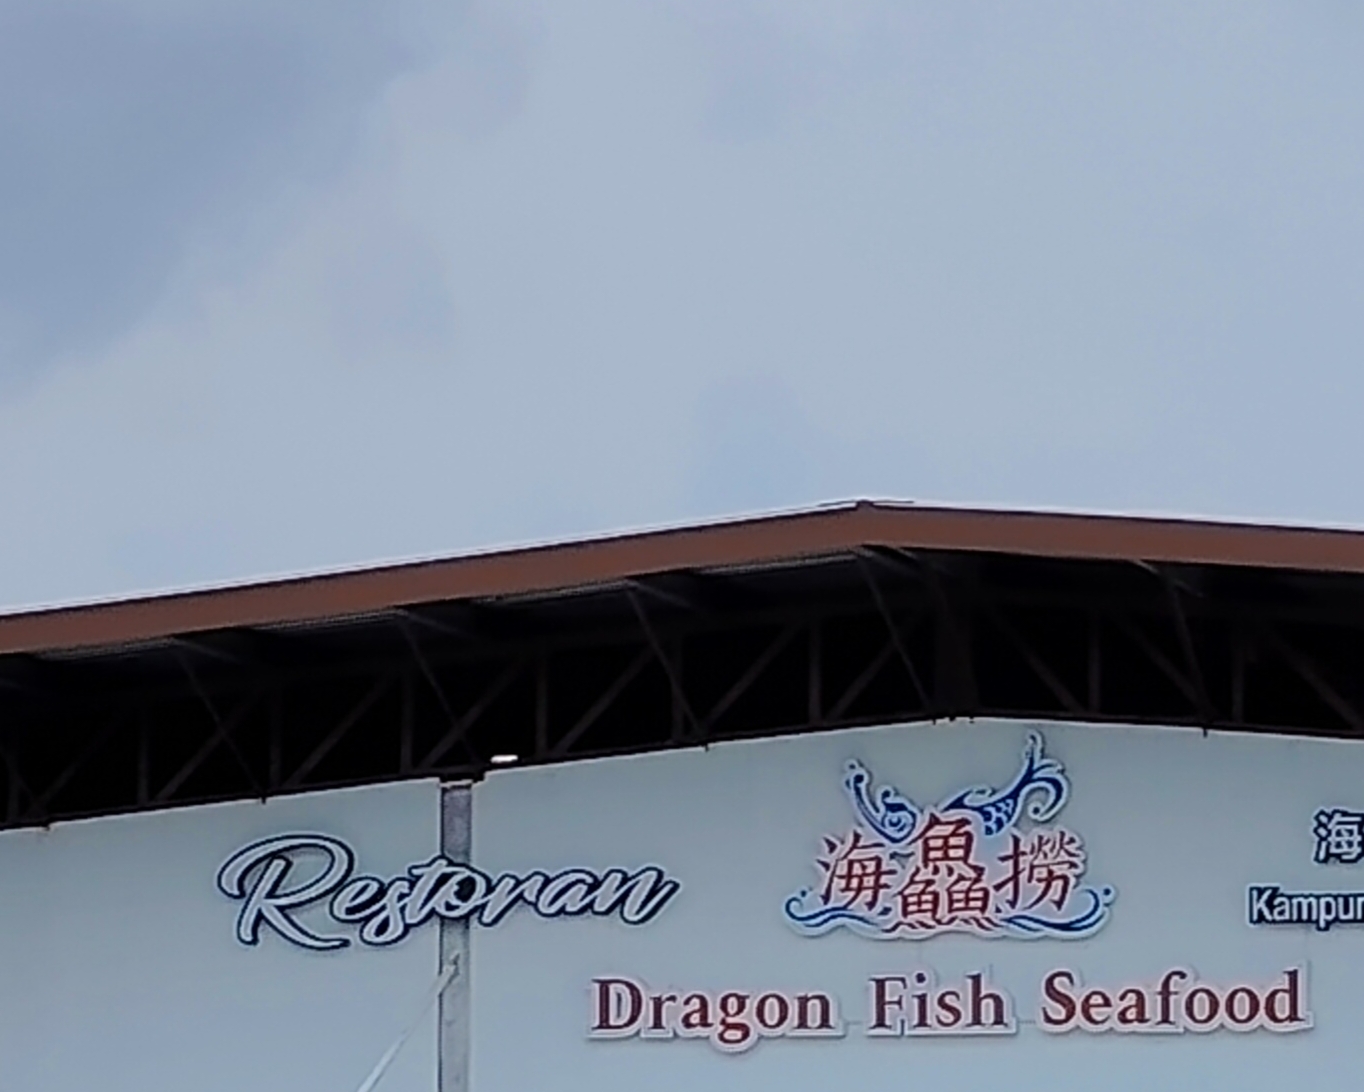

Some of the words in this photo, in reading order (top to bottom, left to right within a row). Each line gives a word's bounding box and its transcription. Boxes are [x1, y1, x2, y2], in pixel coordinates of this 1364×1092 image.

[217, 834, 680, 950] Restoran
[593, 978, 833, 1046] Dragon
[869, 972, 1008, 1030] Fish
[1042, 968, 1304, 1028] Seafood
